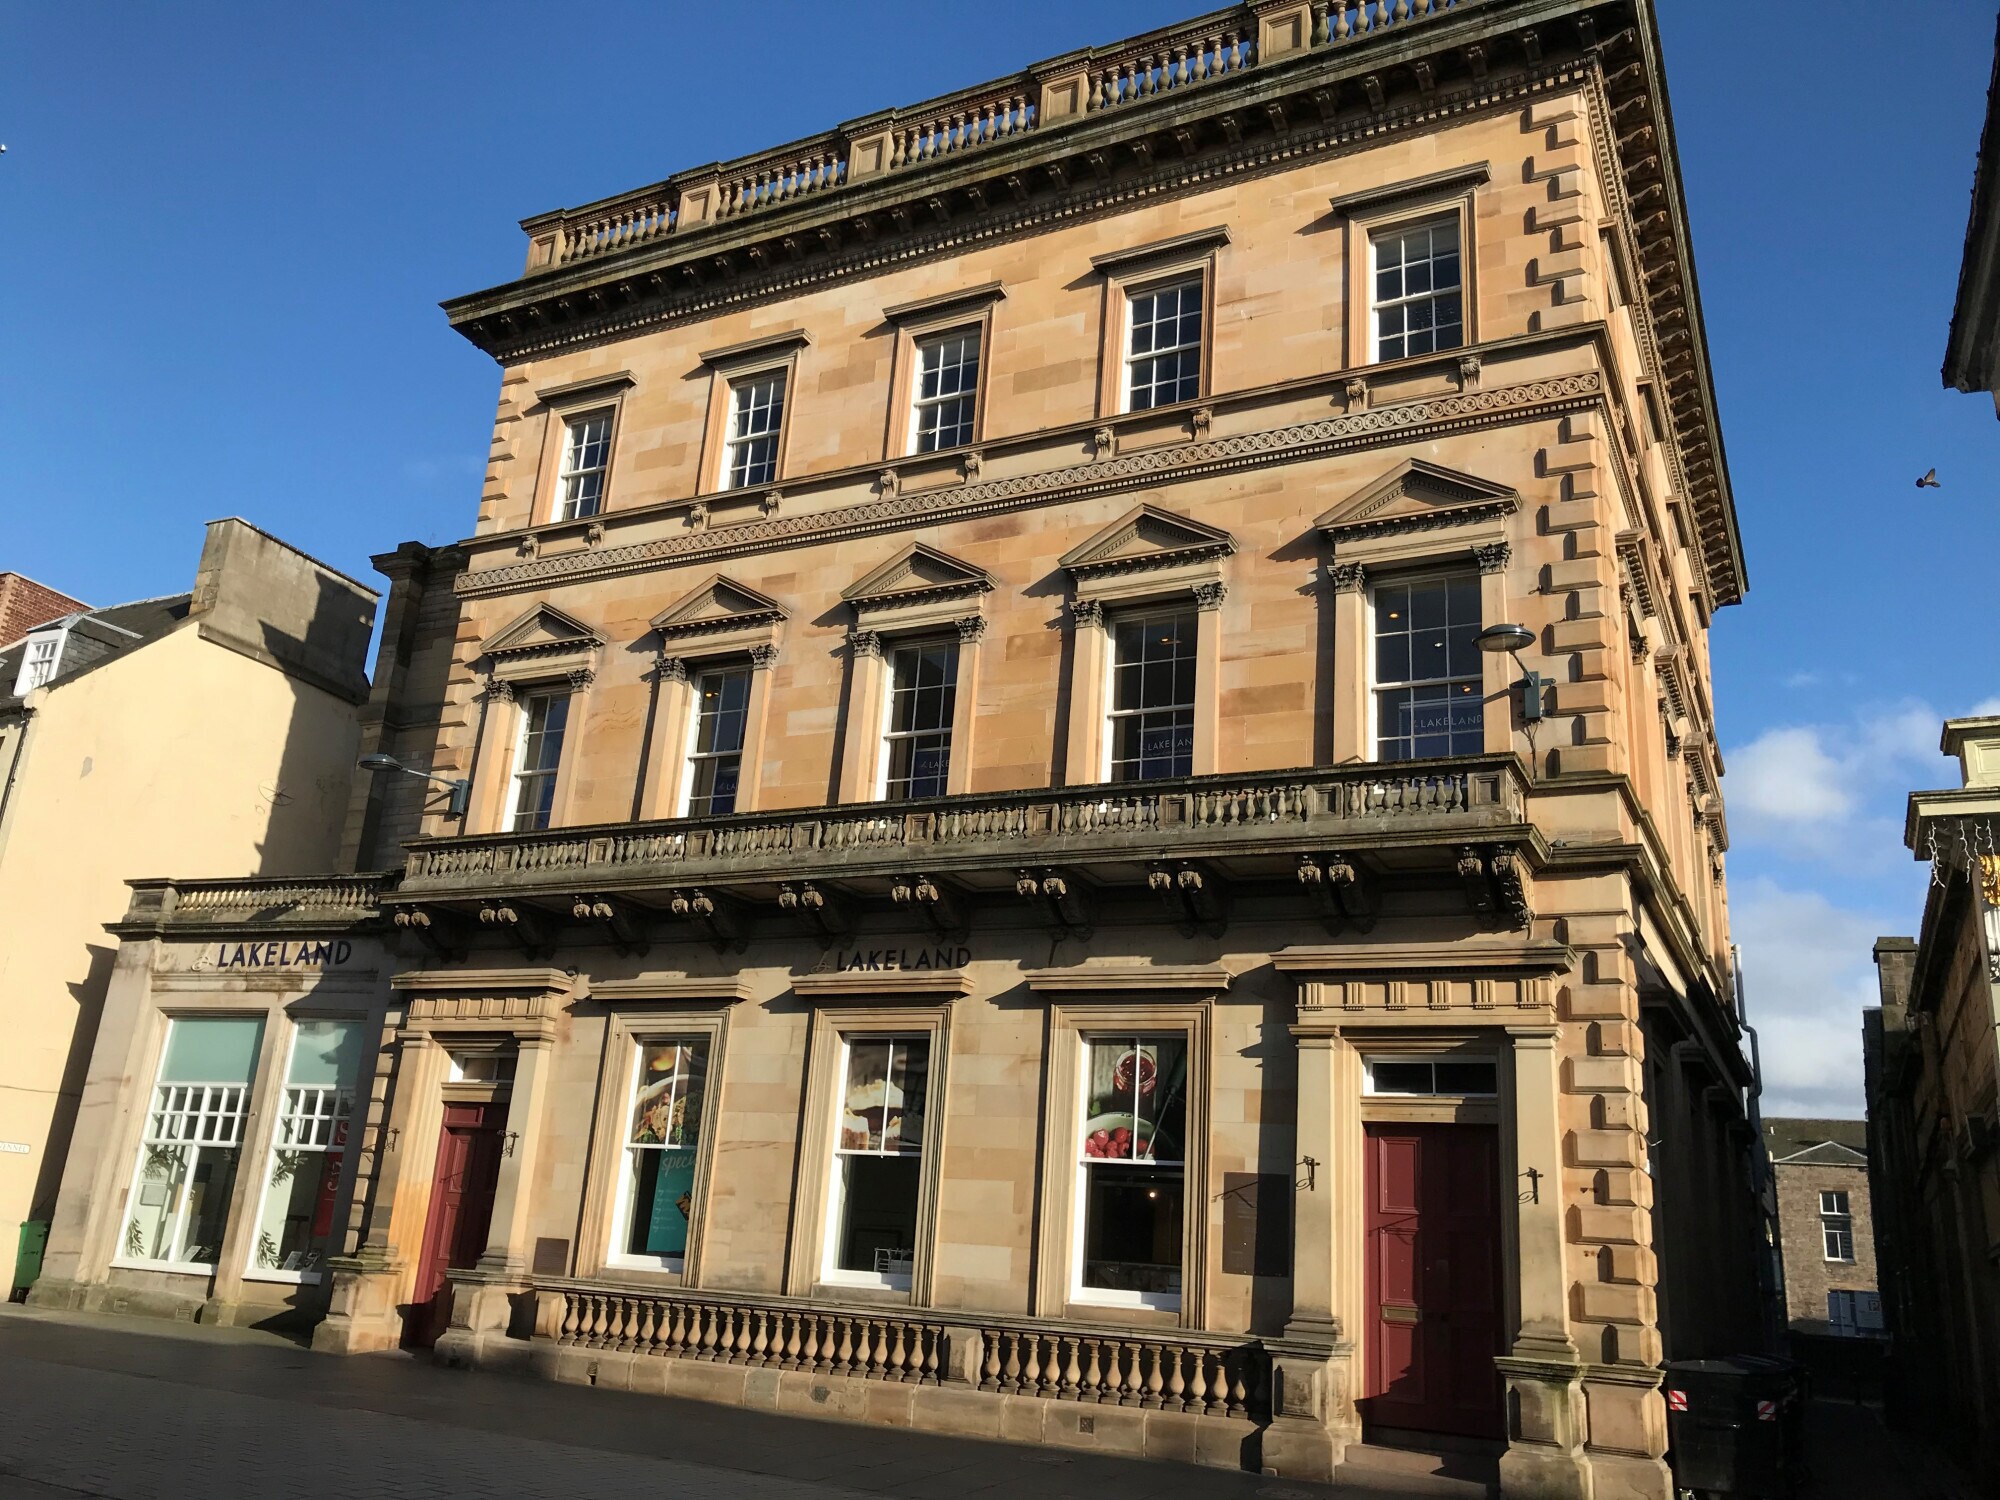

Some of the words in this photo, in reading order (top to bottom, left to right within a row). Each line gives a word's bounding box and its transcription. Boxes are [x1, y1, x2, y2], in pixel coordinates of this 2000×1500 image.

[1420, 714, 1482, 728] LAKELAND
[218, 940, 352, 968] LAKELAND
[836, 947, 972, 972] LAKELAND
[662, 1151, 696, 1178] speci
